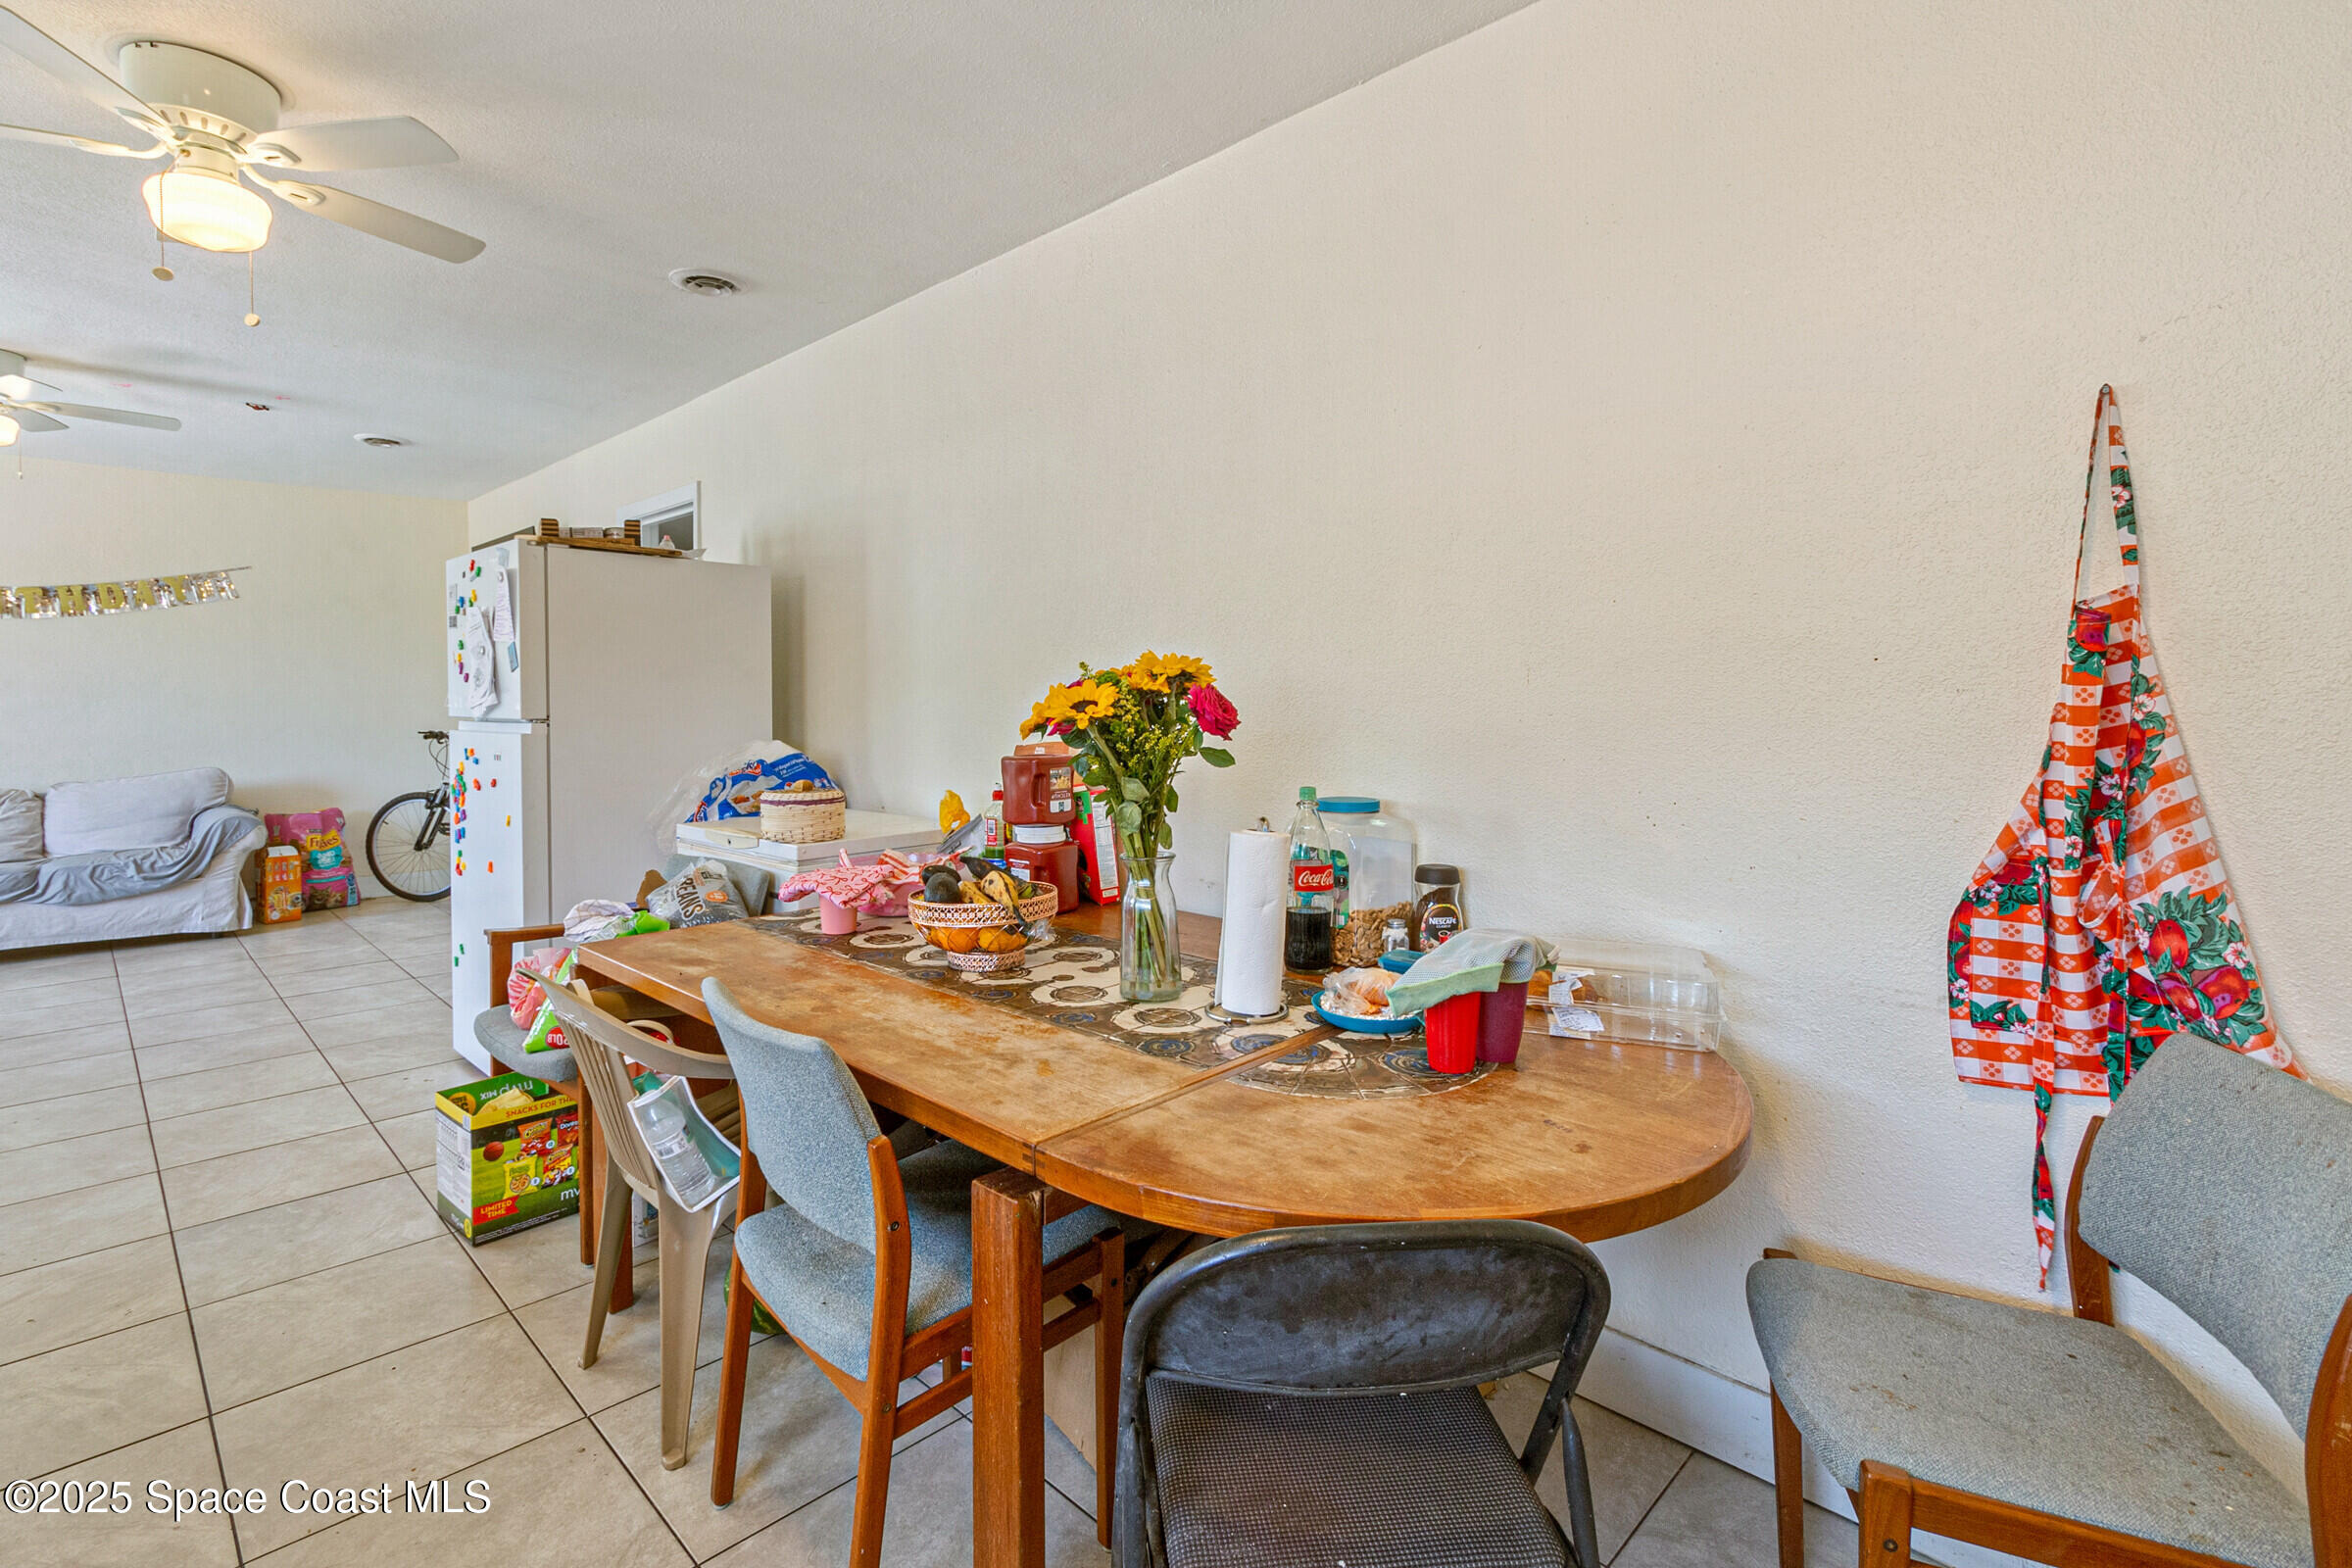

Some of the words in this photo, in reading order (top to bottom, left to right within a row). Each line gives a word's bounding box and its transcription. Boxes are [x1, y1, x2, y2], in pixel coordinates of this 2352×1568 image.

[506, 1105, 538, 1118] SNACKS
[540, 1100, 557, 1109] FOR
[561, 1187, 580, 1200] mv
[480, 1200, 513, 1214] LIMITED
[487, 1208, 507, 1218] TIME
